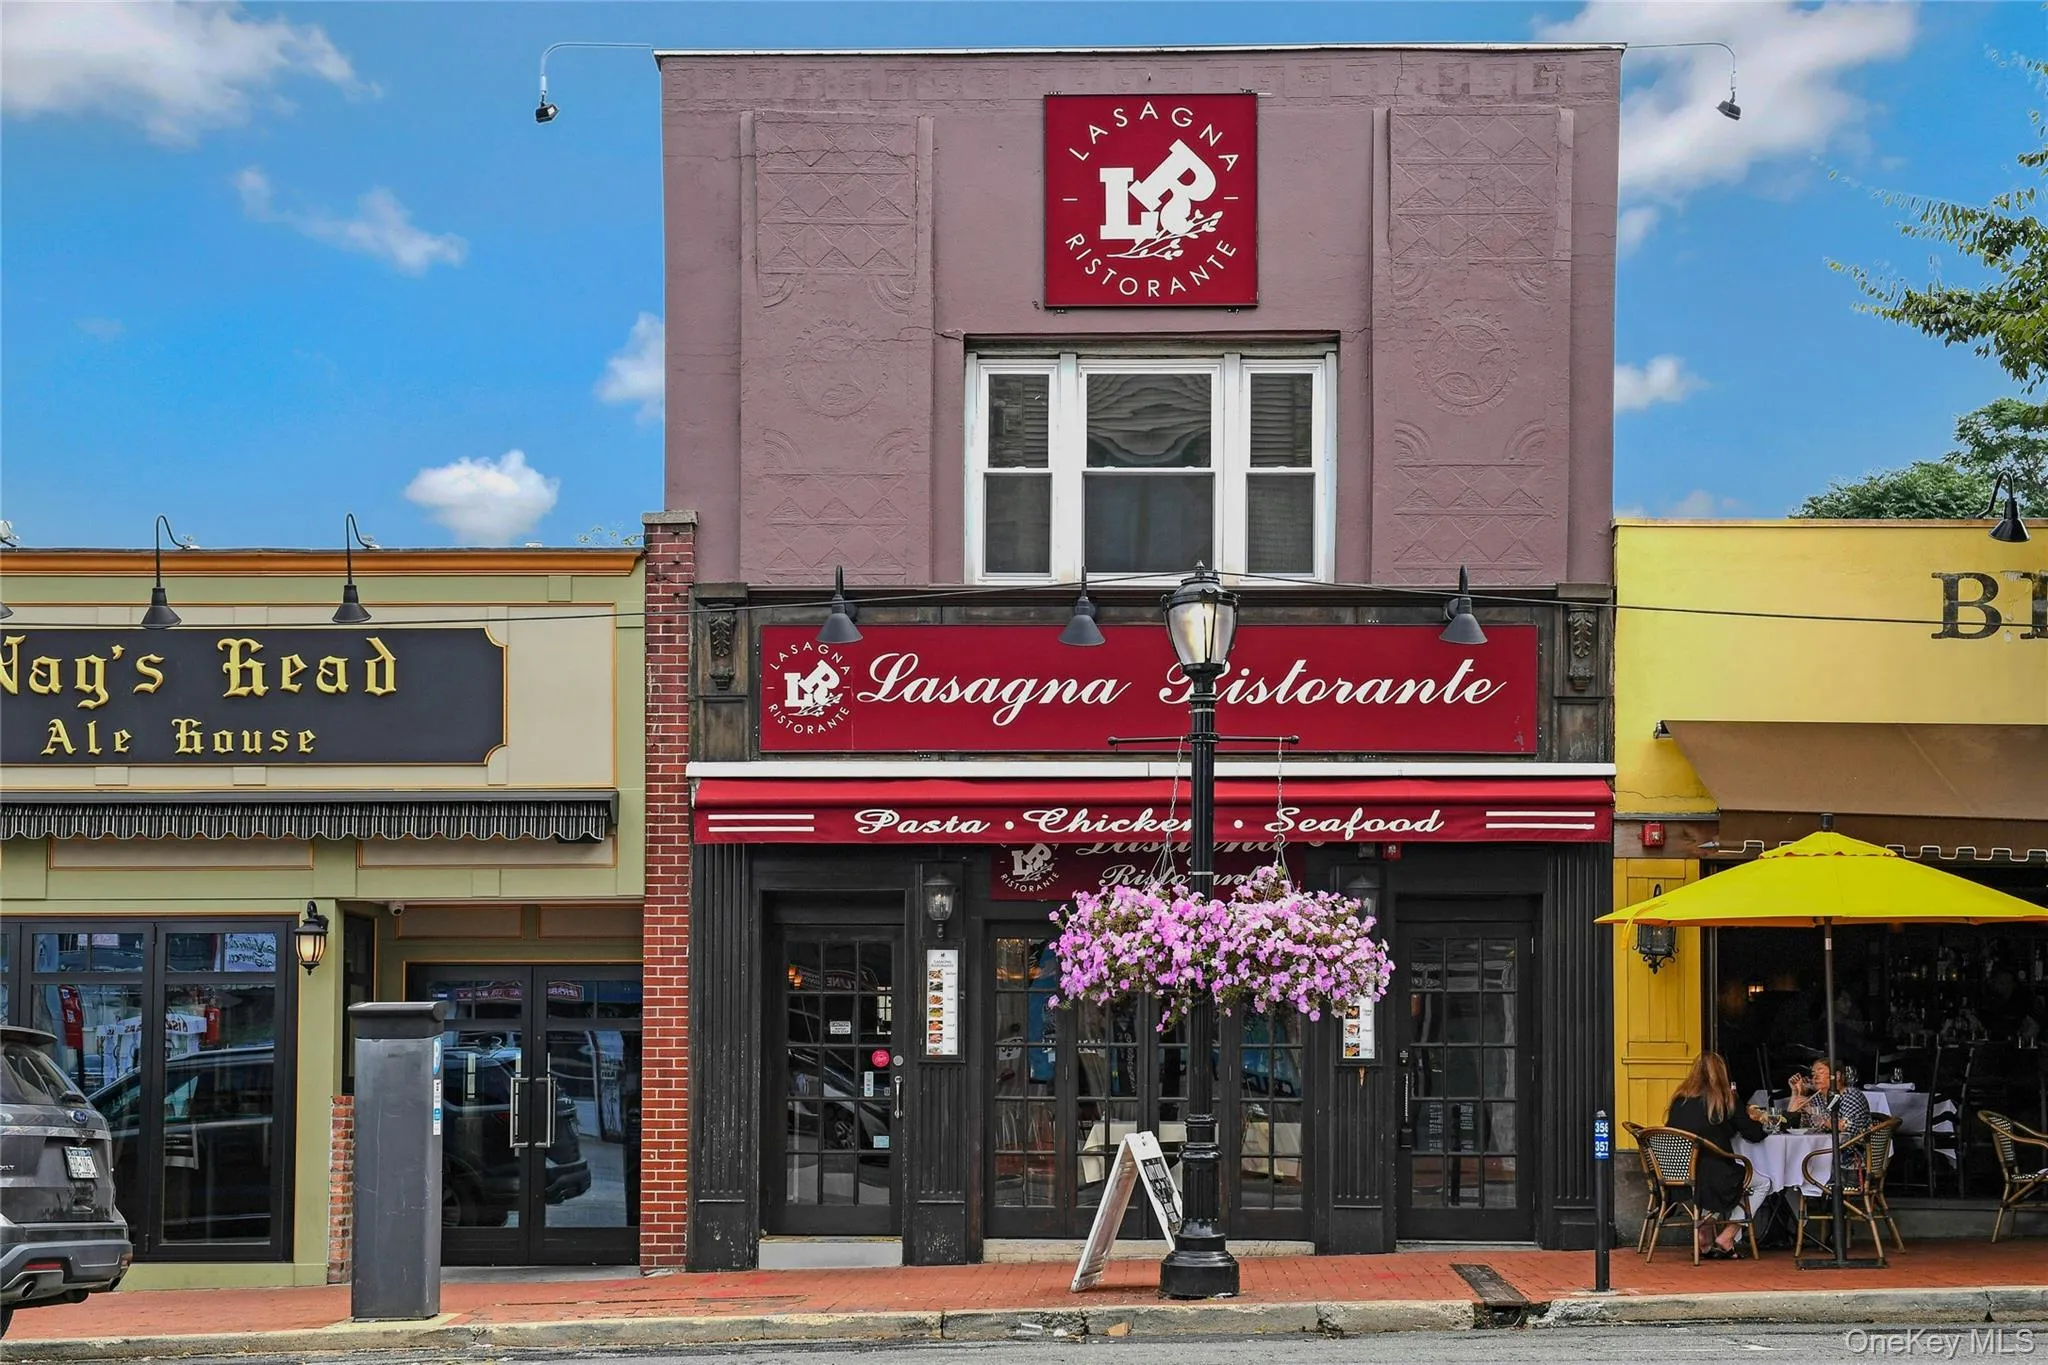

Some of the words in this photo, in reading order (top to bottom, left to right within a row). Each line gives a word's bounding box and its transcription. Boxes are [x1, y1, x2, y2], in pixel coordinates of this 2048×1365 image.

[1068, 101, 1239, 172] LASAGNA
[1065, 232, 1237, 298] RISTORANTE
[217, 636, 398, 698] Head
[769, 641, 851, 676] LASAGNA
[856, 652, 1132, 727] Lasagna
[41, 718, 132, 756] Ale
[171, 718, 317, 755] House
[768, 703, 851, 735] RISTORANTE
[854, 808, 991, 834] Pasta
[1264, 806, 1445, 841] Seafood
[999, 871, 1062, 894] RISTORANTE
[1594, 1141, 1609, 1152] 357
